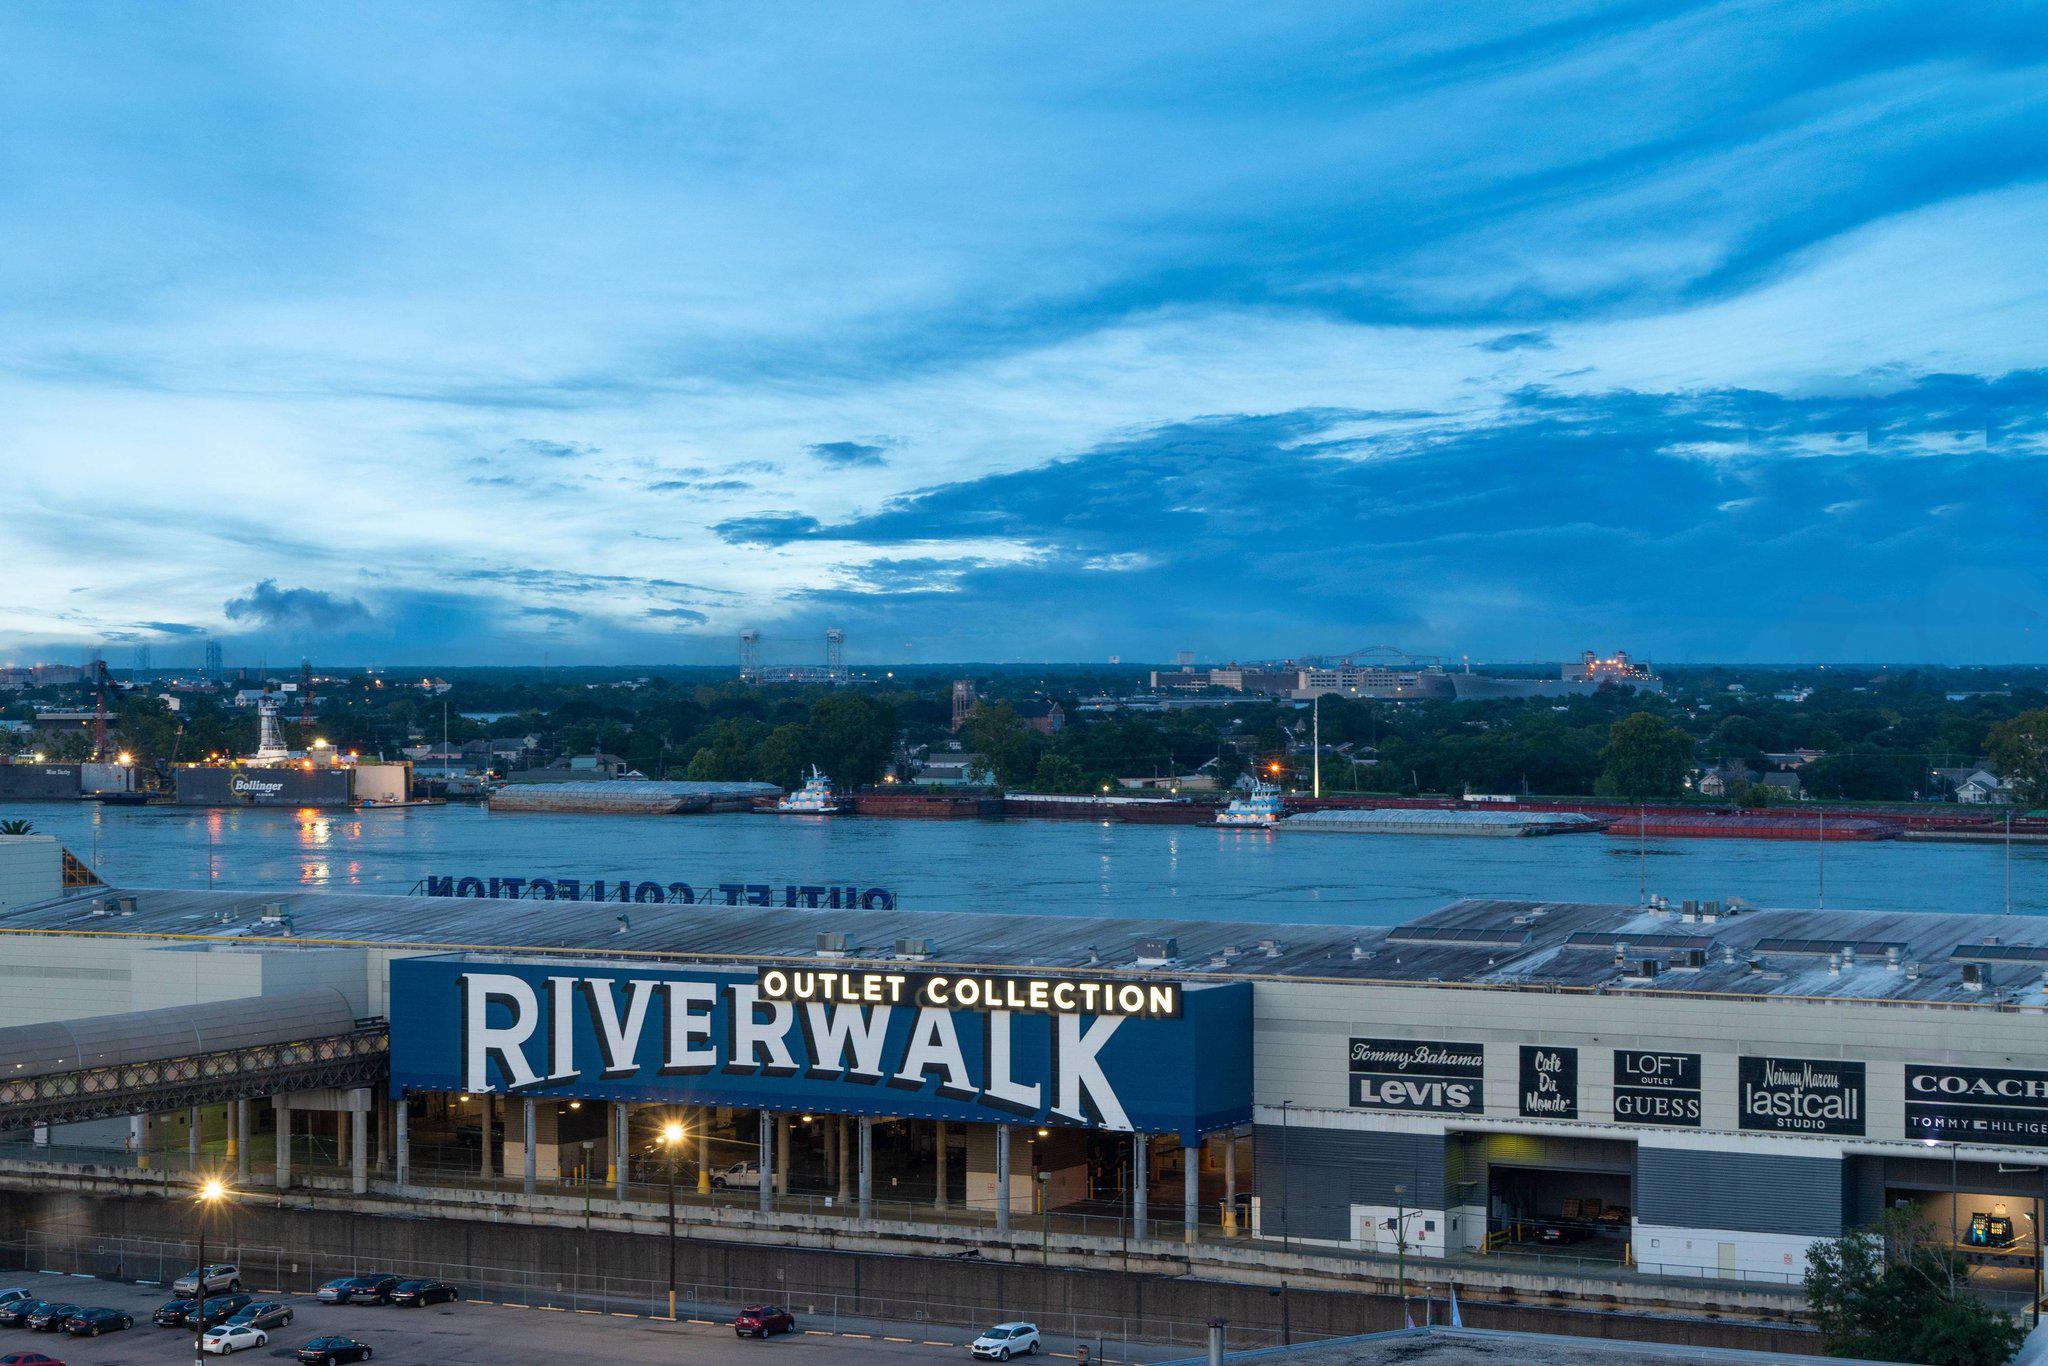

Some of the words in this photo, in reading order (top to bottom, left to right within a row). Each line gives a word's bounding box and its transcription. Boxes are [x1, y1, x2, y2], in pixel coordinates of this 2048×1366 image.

[235, 780, 283, 793] Bollinger
[763, 970, 906, 1002] OUTLET
[926, 976, 1173, 1014] COLLECTION
[460, 972, 1134, 1131] RIVERWALK
[1351, 1043, 1410, 1070] Tommy
[1409, 1045, 1483, 1067] Bahama
[1534, 1051, 1562, 1072] Café
[1626, 1054, 1688, 1076] LOFT
[1762, 1059, 1803, 1089] Neiman
[1799, 1062, 1840, 1091] Marcus
[1641, 1076, 1674, 1085] OUTLET
[1912, 1074, 2048, 1099] COACH
[1615, 1095, 1700, 1119] GUESS
[1746, 1083, 1858, 1120] lastcall
[1776, 1117, 1826, 1130] STUDIO
[1911, 1116, 1969, 1129] TOMMY
